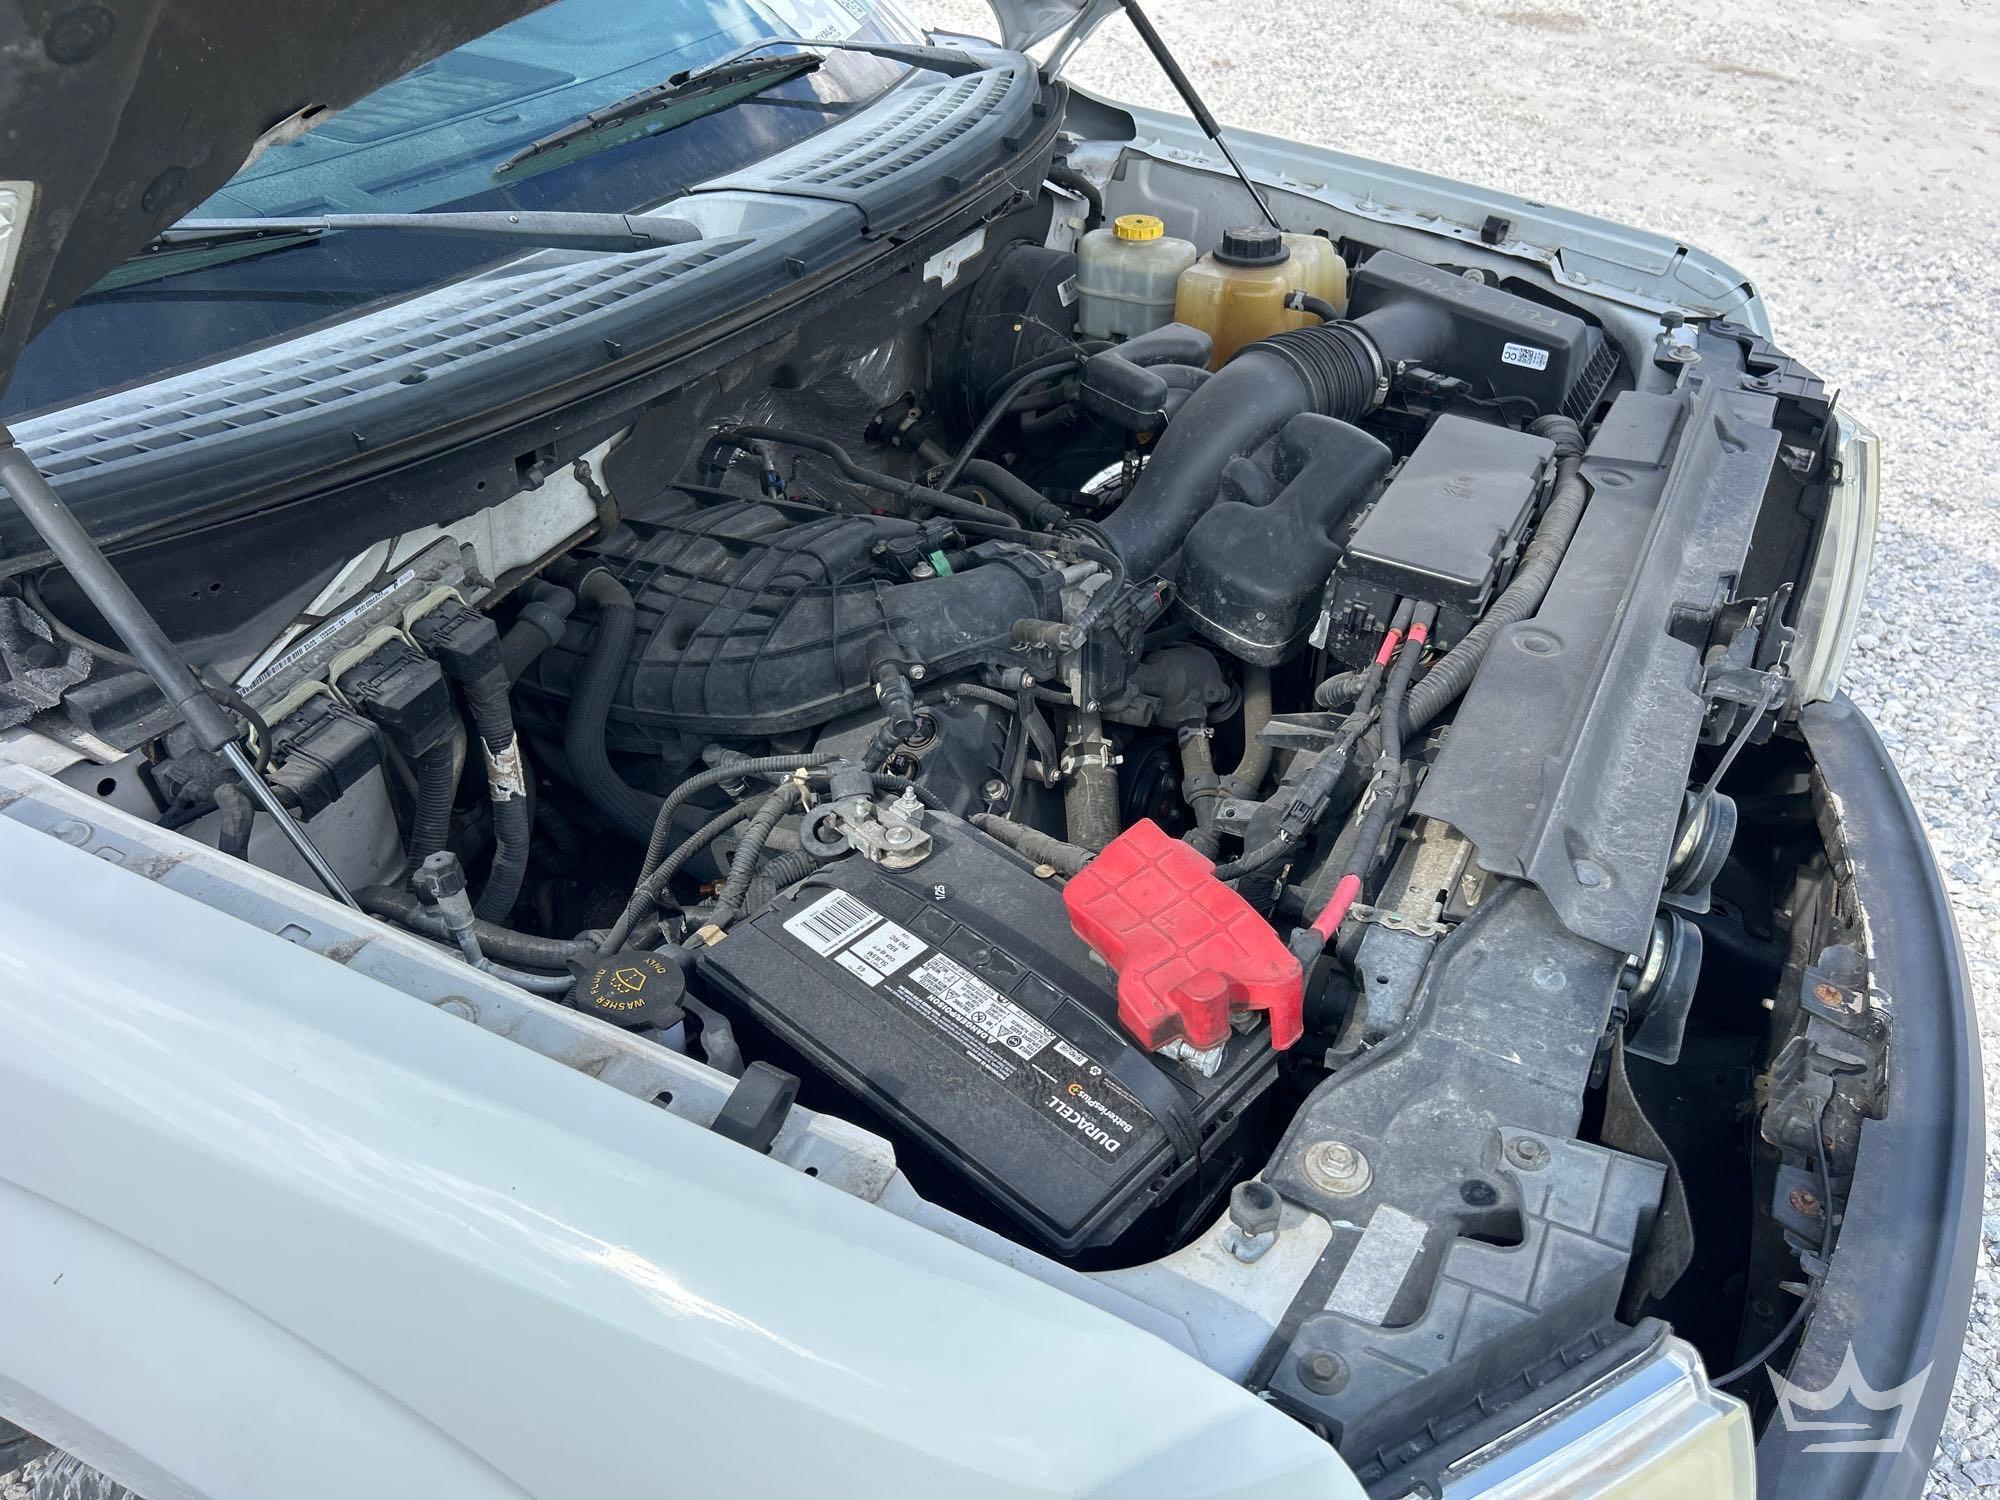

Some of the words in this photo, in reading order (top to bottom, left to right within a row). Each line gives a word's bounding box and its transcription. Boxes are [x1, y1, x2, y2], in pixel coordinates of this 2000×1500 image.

[934, 885, 946, 901] 1/25
[888, 934, 900, 942] RC
[886, 943, 898, 952] 850
[884, 953, 896, 961] CCA
[643, 958, 667, 974] ONLY
[855, 964, 866, 972] 65
[590, 968, 607, 995] FLUID
[596, 995, 646, 1011] WASHER
[925, 993, 989, 1039] DANGER/POISON
[1077, 1090, 1134, 1133] BatteriesPlus
[1047, 1095, 1121, 1152] DURACELL
